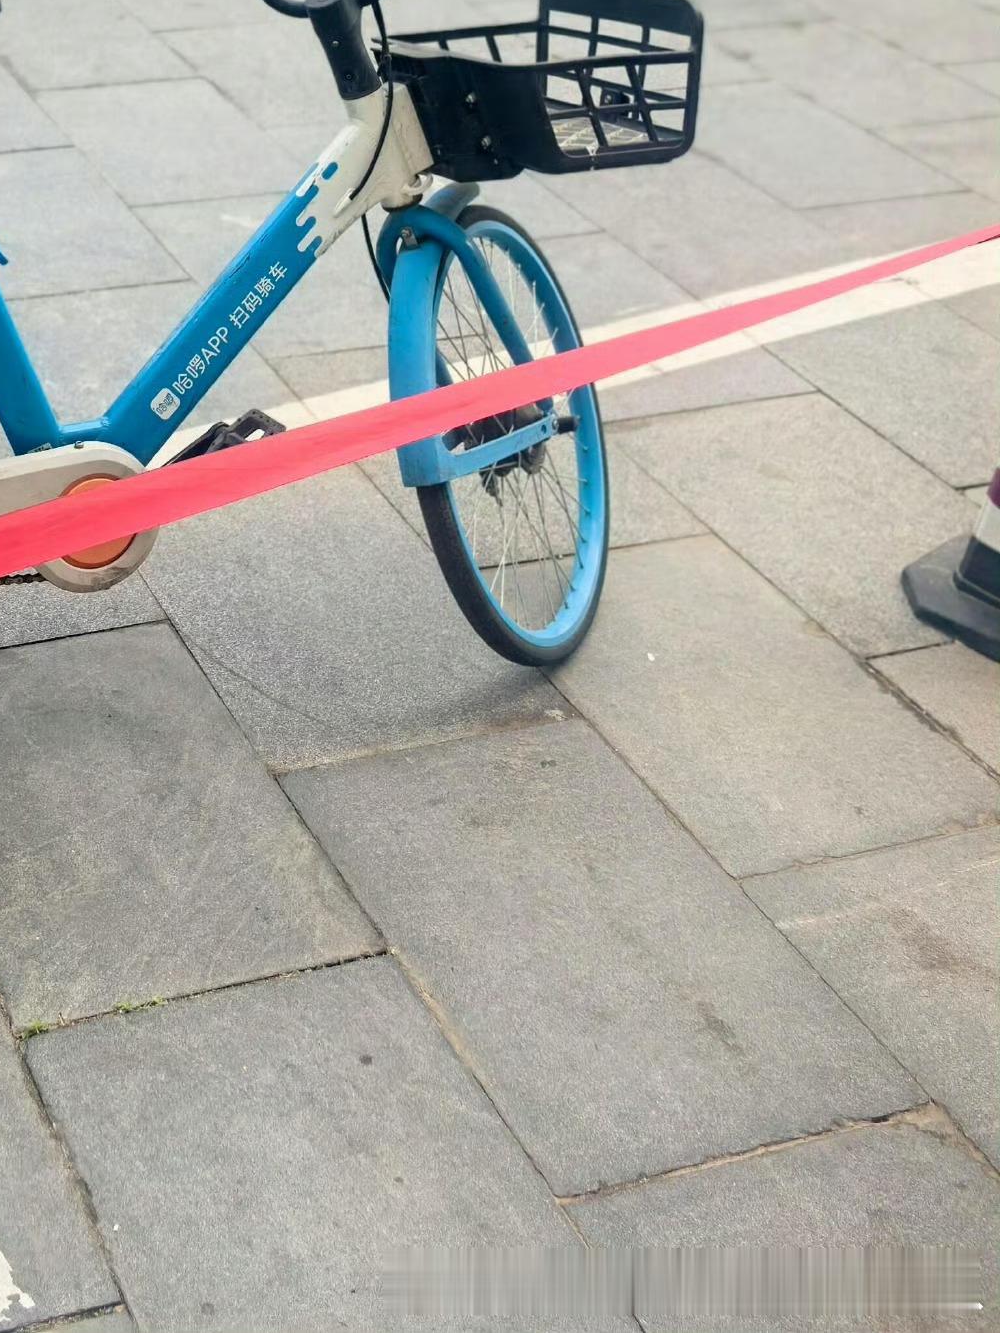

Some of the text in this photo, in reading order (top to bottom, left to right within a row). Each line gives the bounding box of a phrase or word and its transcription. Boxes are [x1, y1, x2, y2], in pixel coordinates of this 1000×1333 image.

[172, 262, 288, 394] 哈啰APP 扫码骑车
